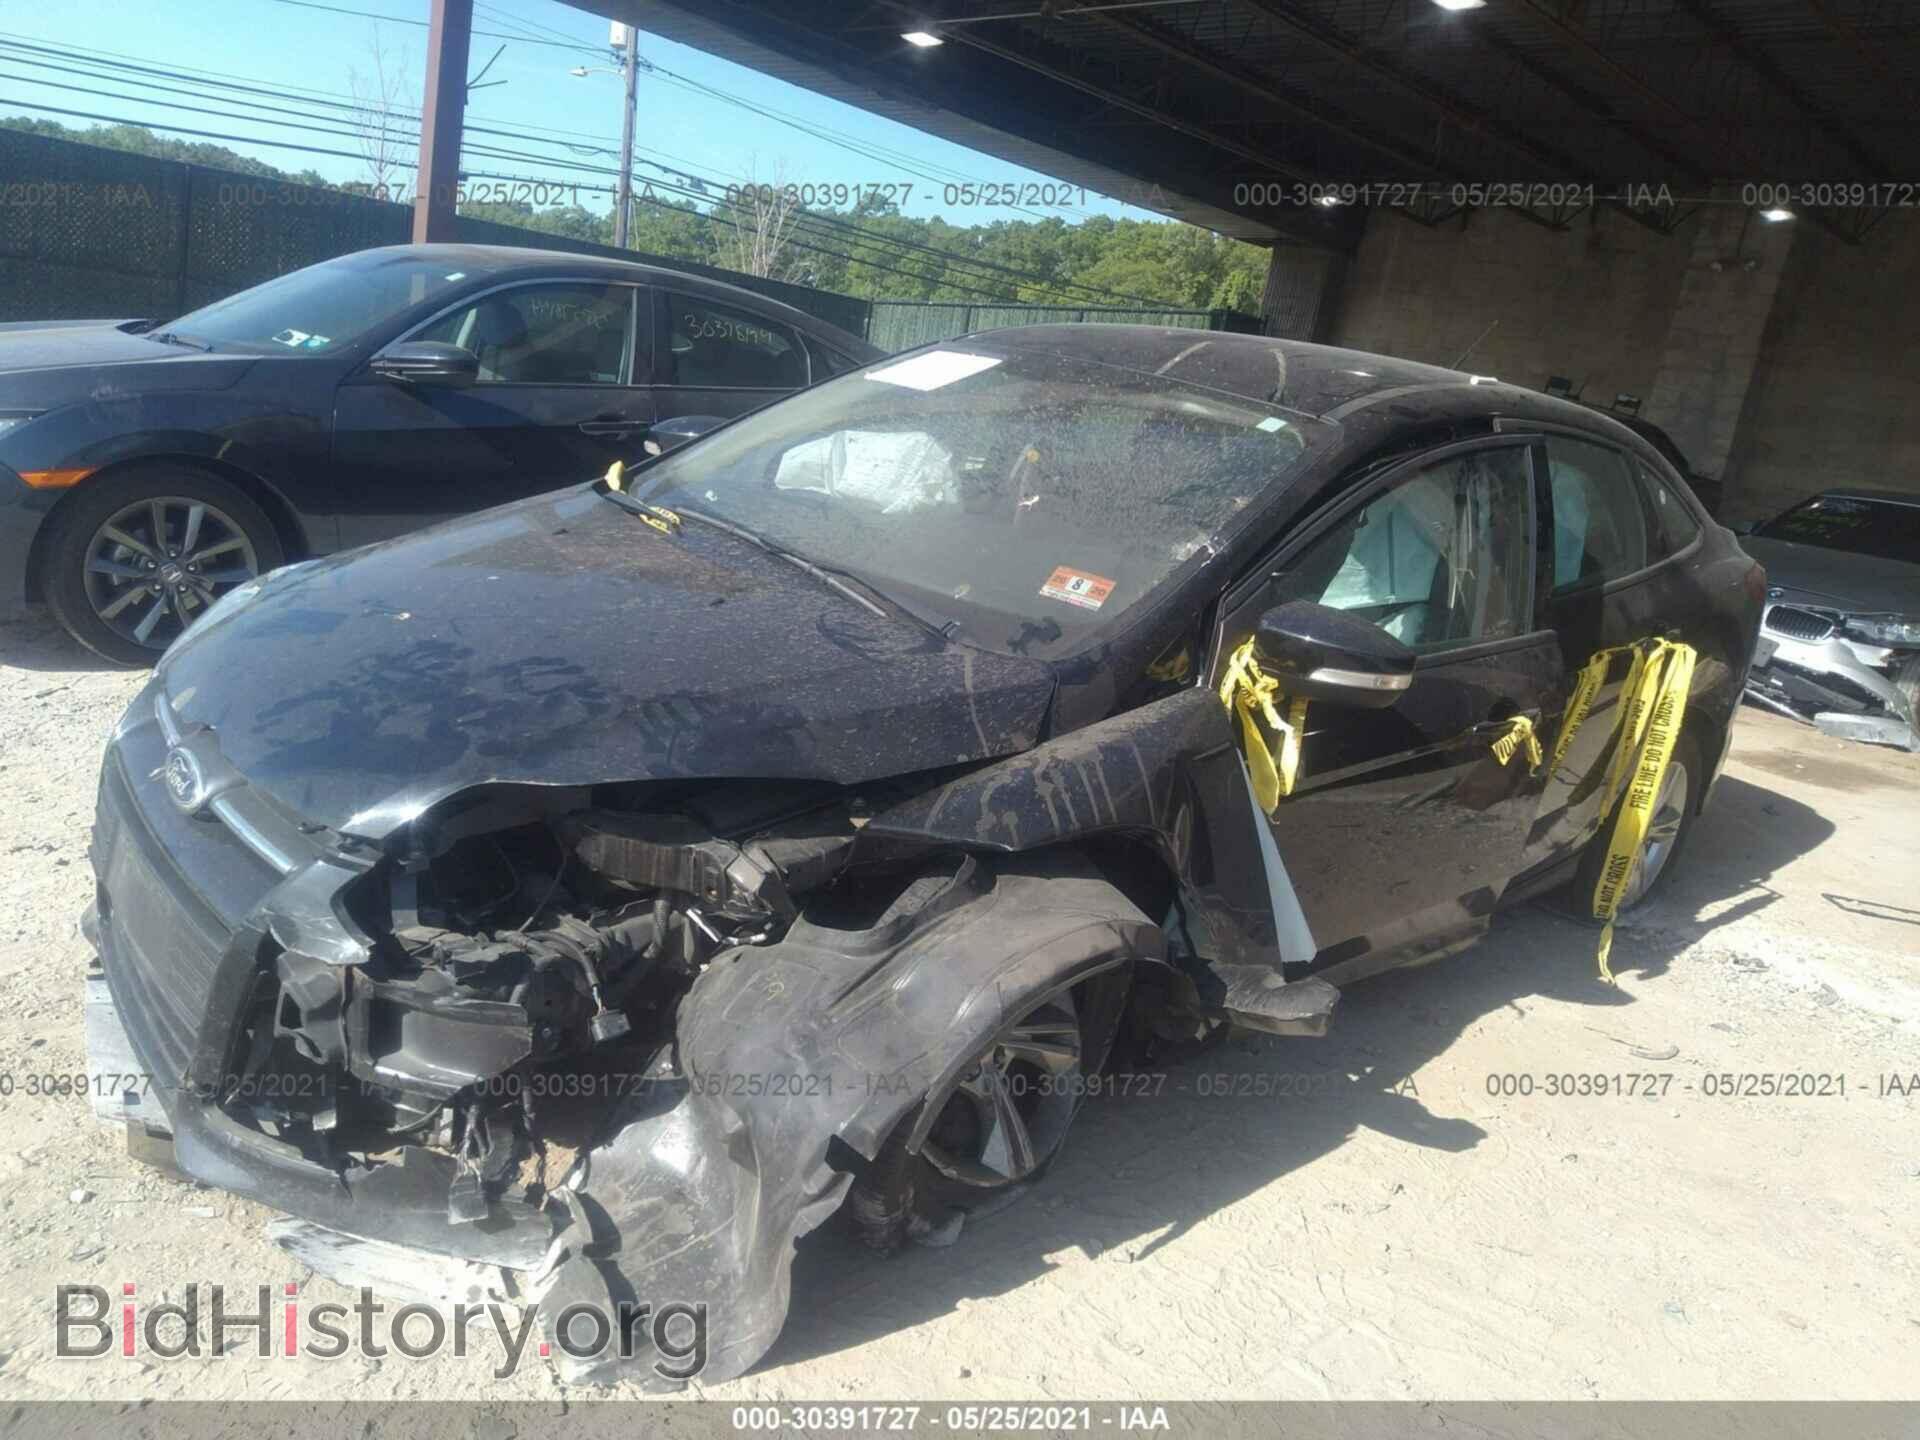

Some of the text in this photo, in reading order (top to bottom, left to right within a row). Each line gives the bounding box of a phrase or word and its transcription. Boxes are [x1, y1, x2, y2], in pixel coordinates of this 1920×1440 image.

[1071, 578, 1084, 591] 8
[1648, 729, 1668, 748] NOT
[1645, 747, 1663, 764] DO
[167, 756, 192, 796] Ford
[1630, 786, 1652, 810] FIRE
[1606, 854, 1630, 885] CROSS
